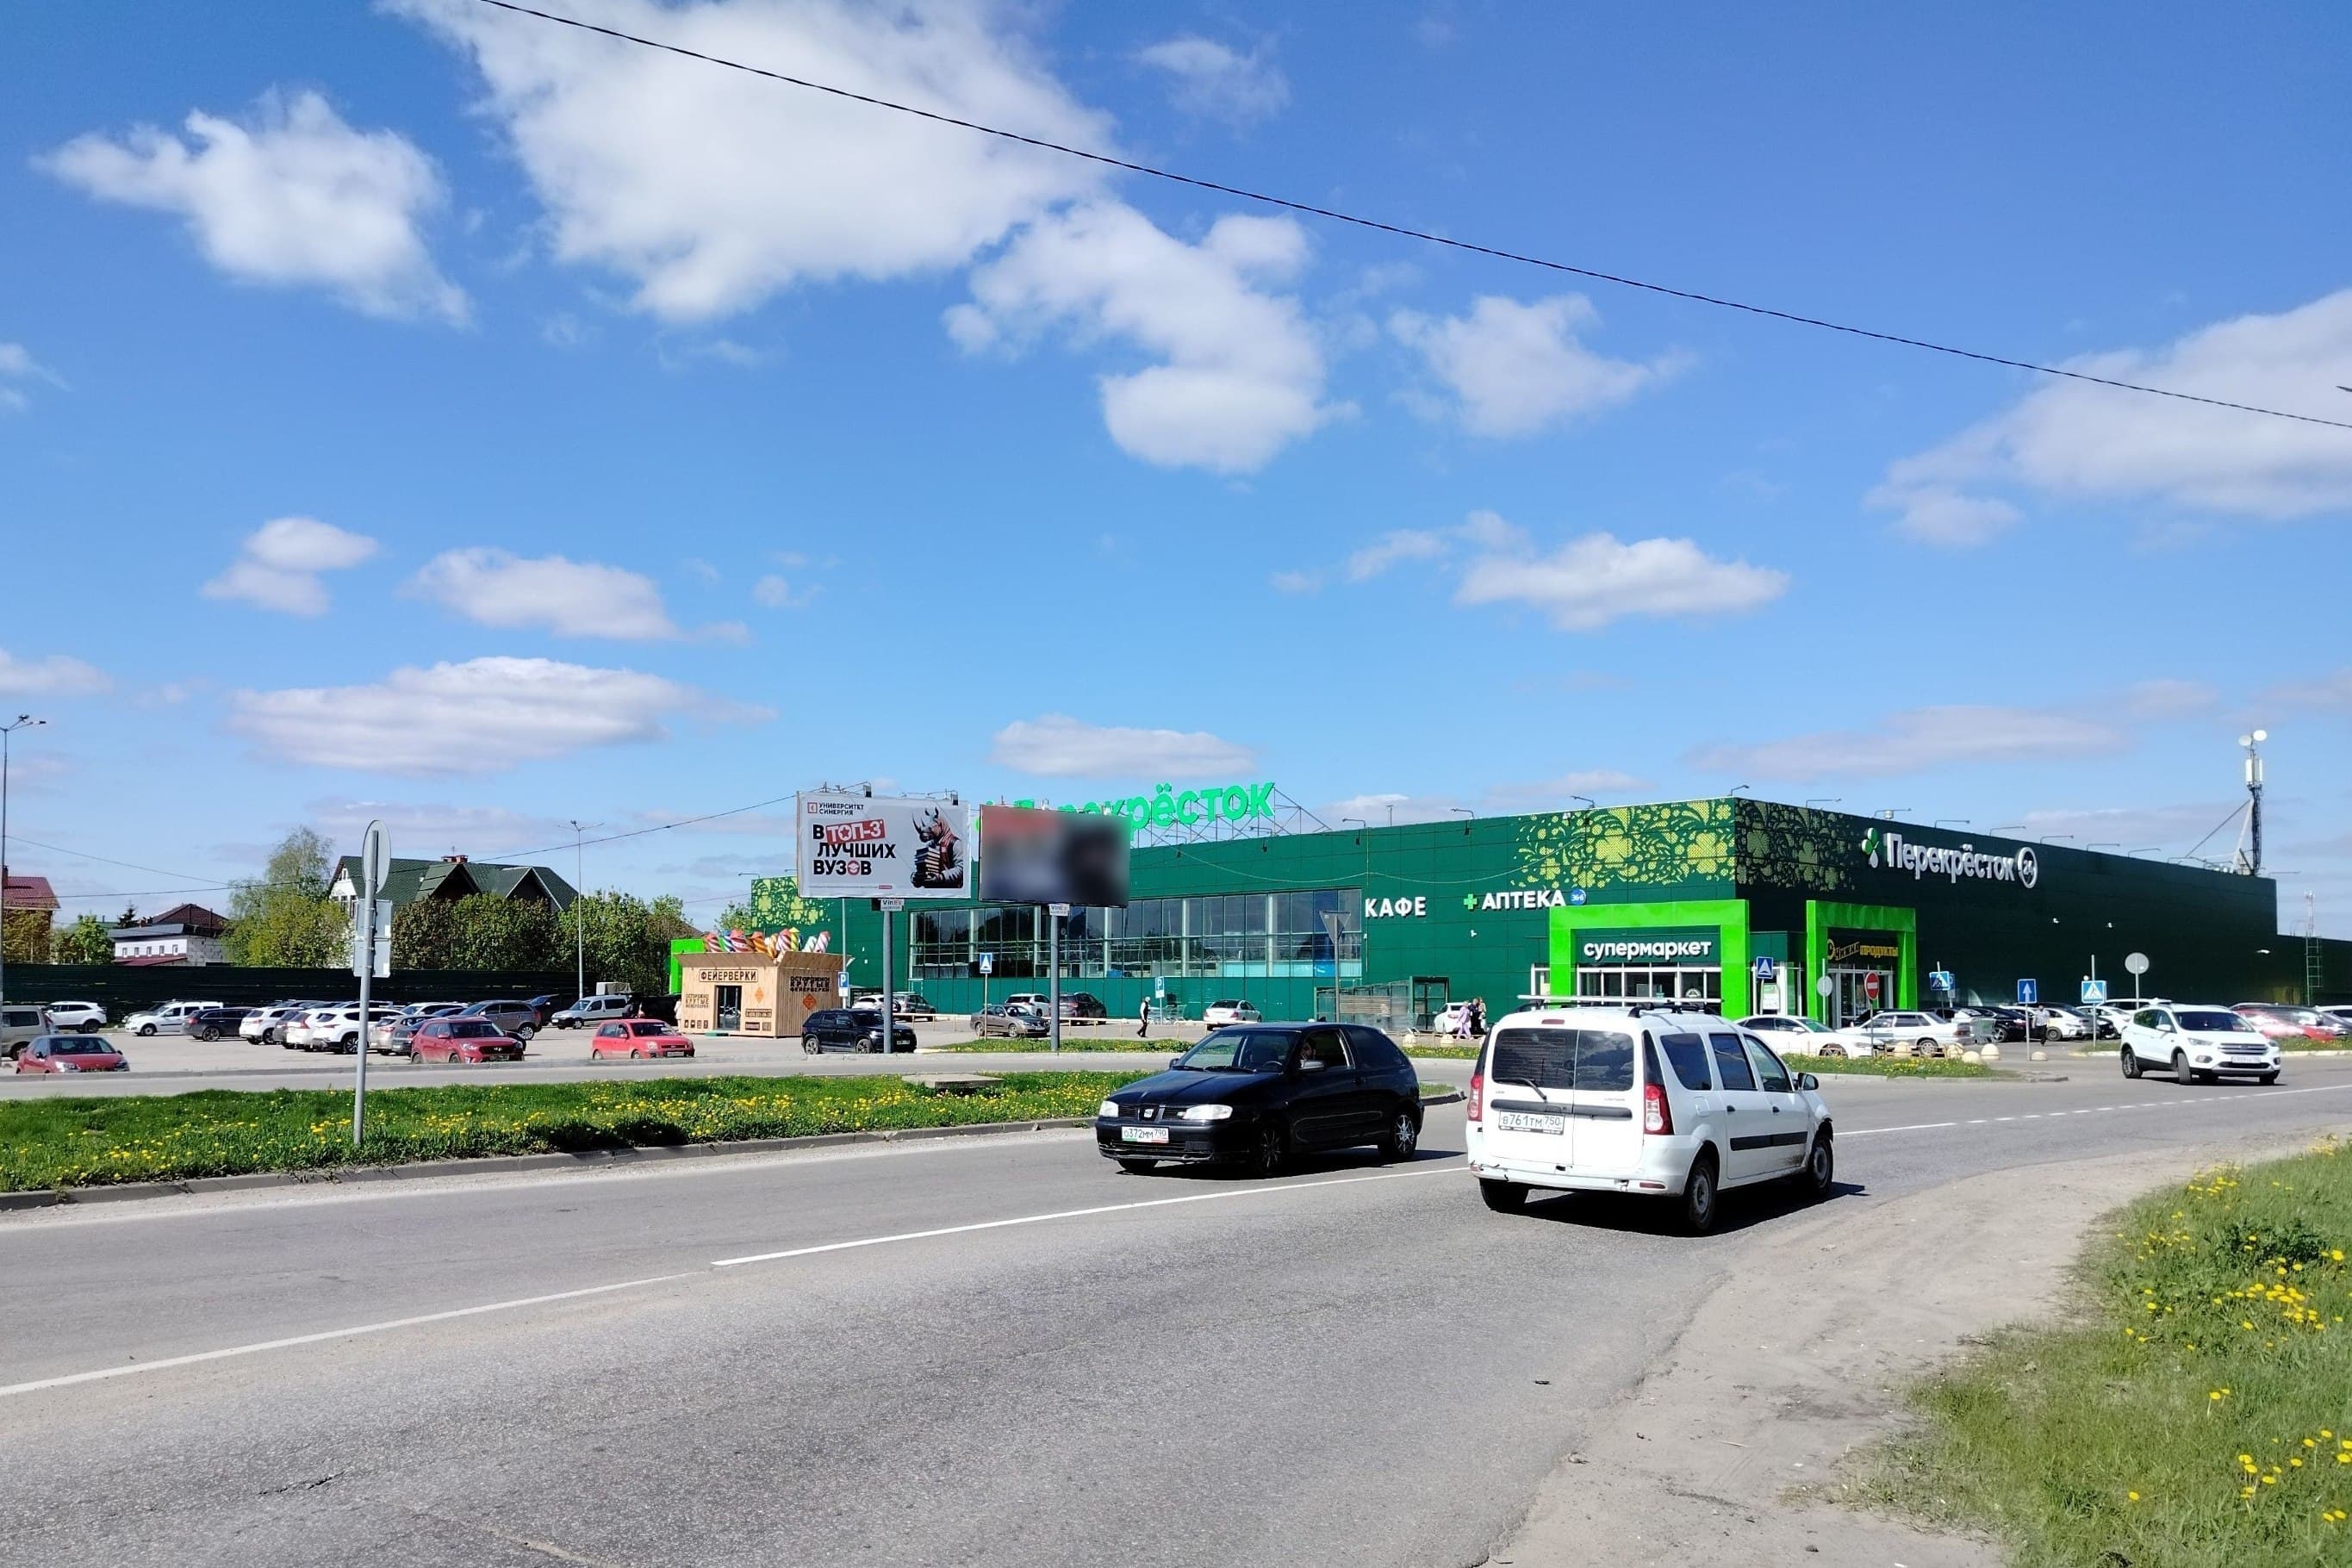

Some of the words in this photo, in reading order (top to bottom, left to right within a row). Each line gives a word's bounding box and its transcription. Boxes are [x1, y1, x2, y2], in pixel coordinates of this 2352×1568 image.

[812, 824, 825, 840] В
[817, 842, 897, 859] ЛУЧШИХ
[1883, 831, 2015, 884] Перекрёсток
[812, 859, 872, 876] ВУЗОВ
[1365, 896, 1427, 918] КАФЕ
[1482, 889, 1566, 910] АПТЕКА
[1584, 941, 1712, 961] супермаркет
[700, 970, 756, 981] ФЕЙЕРВЕРКИ
